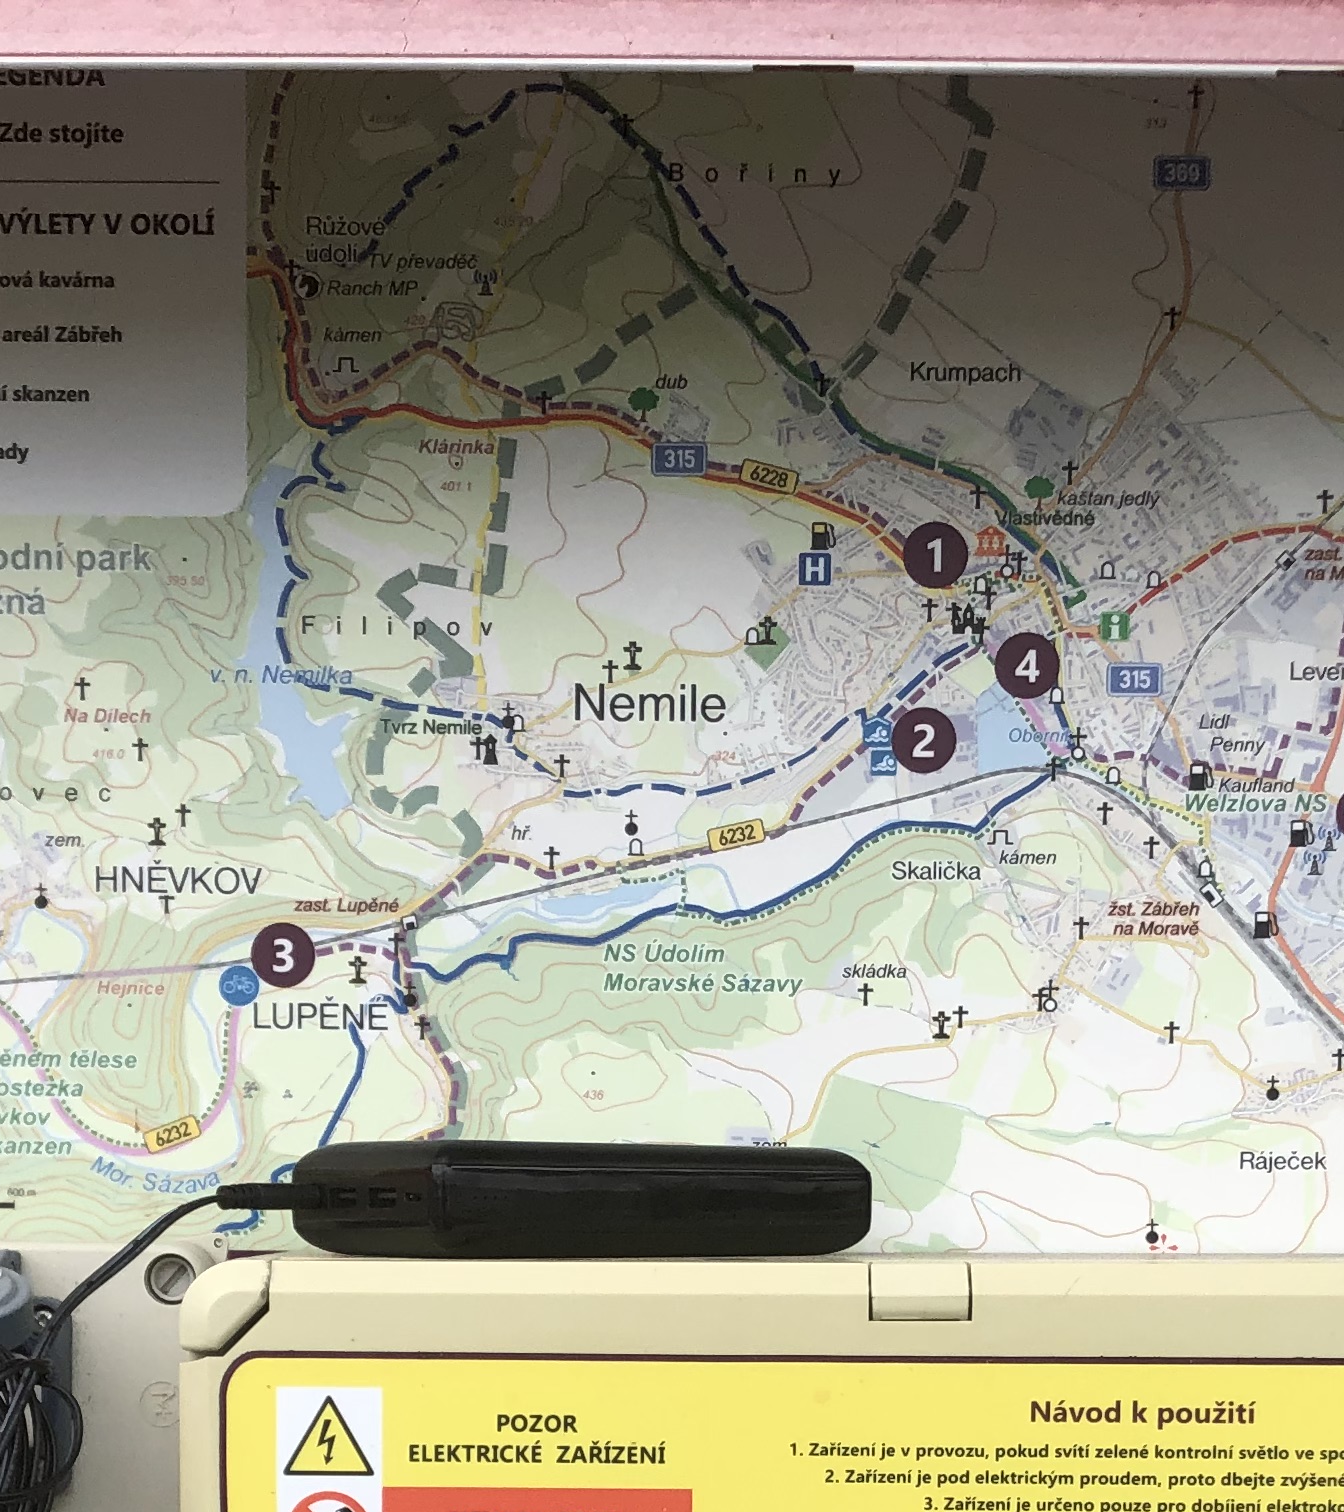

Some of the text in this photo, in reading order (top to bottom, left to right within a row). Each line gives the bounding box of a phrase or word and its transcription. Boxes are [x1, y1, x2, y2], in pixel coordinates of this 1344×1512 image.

[48, 121, 124, 149] stojíte
[103, 213, 123, 235] V
[130, 207, 215, 236] OKOLÍ
[39, 269, 115, 289] kavárna
[1, 324, 51, 343] areál
[54, 325, 123, 343] Zábřeh
[909, 362, 1021, 385] Krumpach
[11, 384, 90, 403] skanzen
[77, 544, 152, 575] park
[926, 538, 944, 573] 1
[1015, 650, 1040, 682] 4
[1119, 670, 1150, 689] 315
[573, 683, 727, 723] Nemile
[1199, 714, 1231, 730] Lidl
[911, 723, 936, 757] 2
[1210, 736, 1265, 756] Penny
[1219, 777, 1296, 794] Kaufland
[1185, 793, 1327, 813] Welzlova NS
[719, 824, 755, 846] 6232
[94, 860, 263, 894] HNĚVKOV
[891, 860, 982, 881] Skalička
[1109, 902, 1200, 918] žst. Zábřeh
[1113, 920, 1200, 936] na Moravě
[271, 939, 295, 972] 3
[603, 939, 725, 964] NS Údolím
[842, 963, 907, 980] skládka
[603, 972, 803, 998] Moravské Sázavy
[253, 995, 389, 1032] LUPĚNÉ
[69, 1049, 138, 1069] tělese
[1239, 1151, 1327, 1173] Ráječek
[496, 1414, 578, 1433] POZOR
[1030, 1399, 1257, 1431] Návod k použití
[409, 1439, 666, 1465] ELEKTRICKÉ ZAŘÍZENÍ
[789, 1442, 804, 1457] 1.
[808, 1442, 876, 1457] Zařízení
[879, 1442, 896, 1461] je
[900, 1446, 911, 1457] v
[916, 1446, 989, 1462] provozu,
[995, 1443, 1049, 1462] pokud
[1054, 1443, 1090, 1459] svítí
[1094, 1443, 1149, 1459] zelené
[1154, 1444, 1234, 1460] kontrolní
[1238, 1445, 1290, 1460] světlo
[1294, 1449, 1315, 1461] ve
